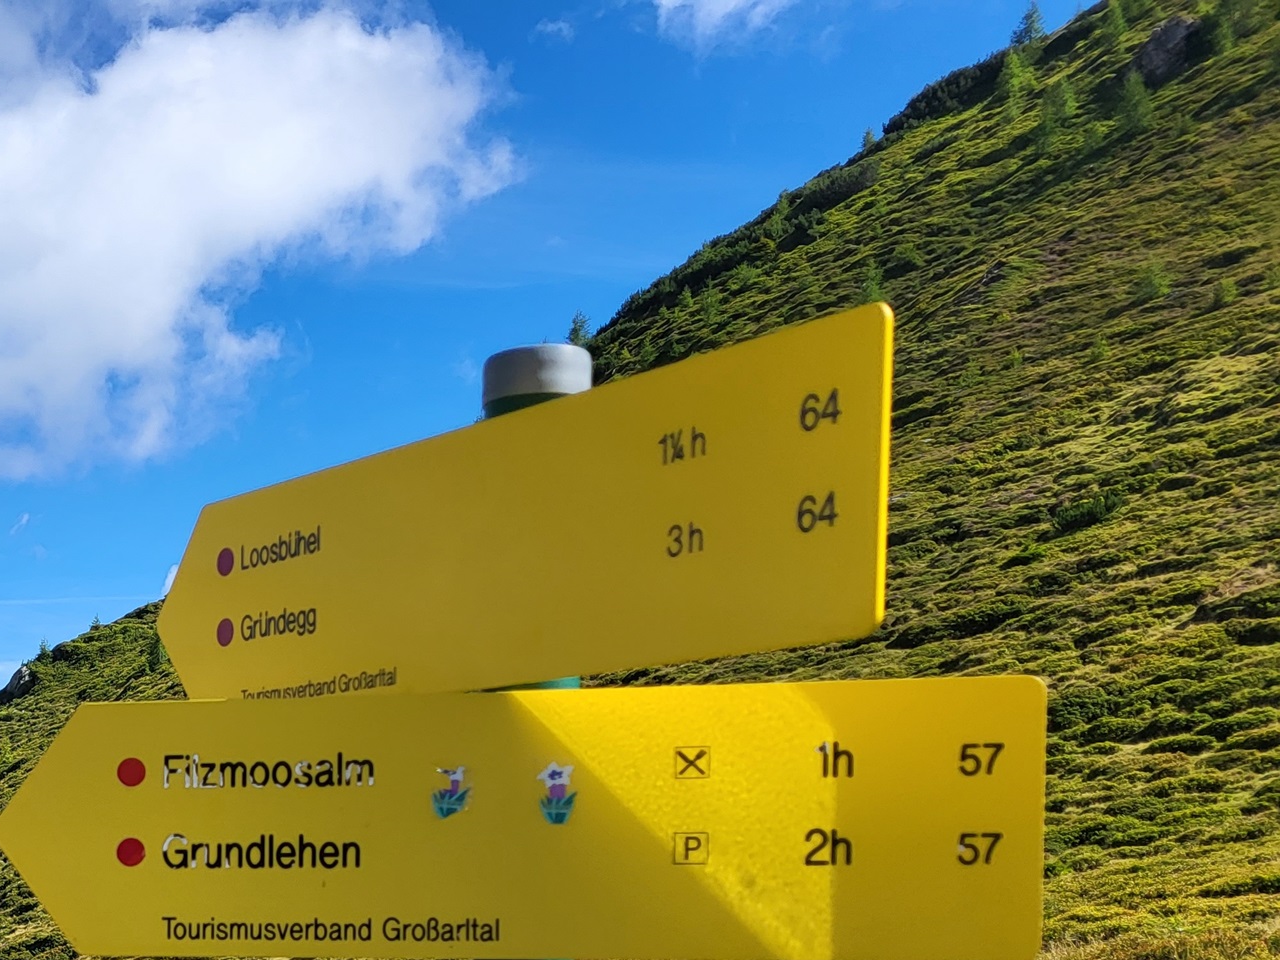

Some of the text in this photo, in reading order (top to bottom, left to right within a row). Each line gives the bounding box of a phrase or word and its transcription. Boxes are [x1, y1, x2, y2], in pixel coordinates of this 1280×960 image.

[240, 525, 321, 571] Loosbühel
[798, 387, 842, 432] 64
[240, 607, 317, 642] Gründegg
[796, 490, 839, 533] 64
[162, 752, 375, 789] Filzmoosalm
[958, 742, 1005, 776] 57
[161, 834, 362, 870] Grundlehen
[956, 832, 1004, 866] 57
[161, 916, 501, 942] Tourismusverband Großarltal
